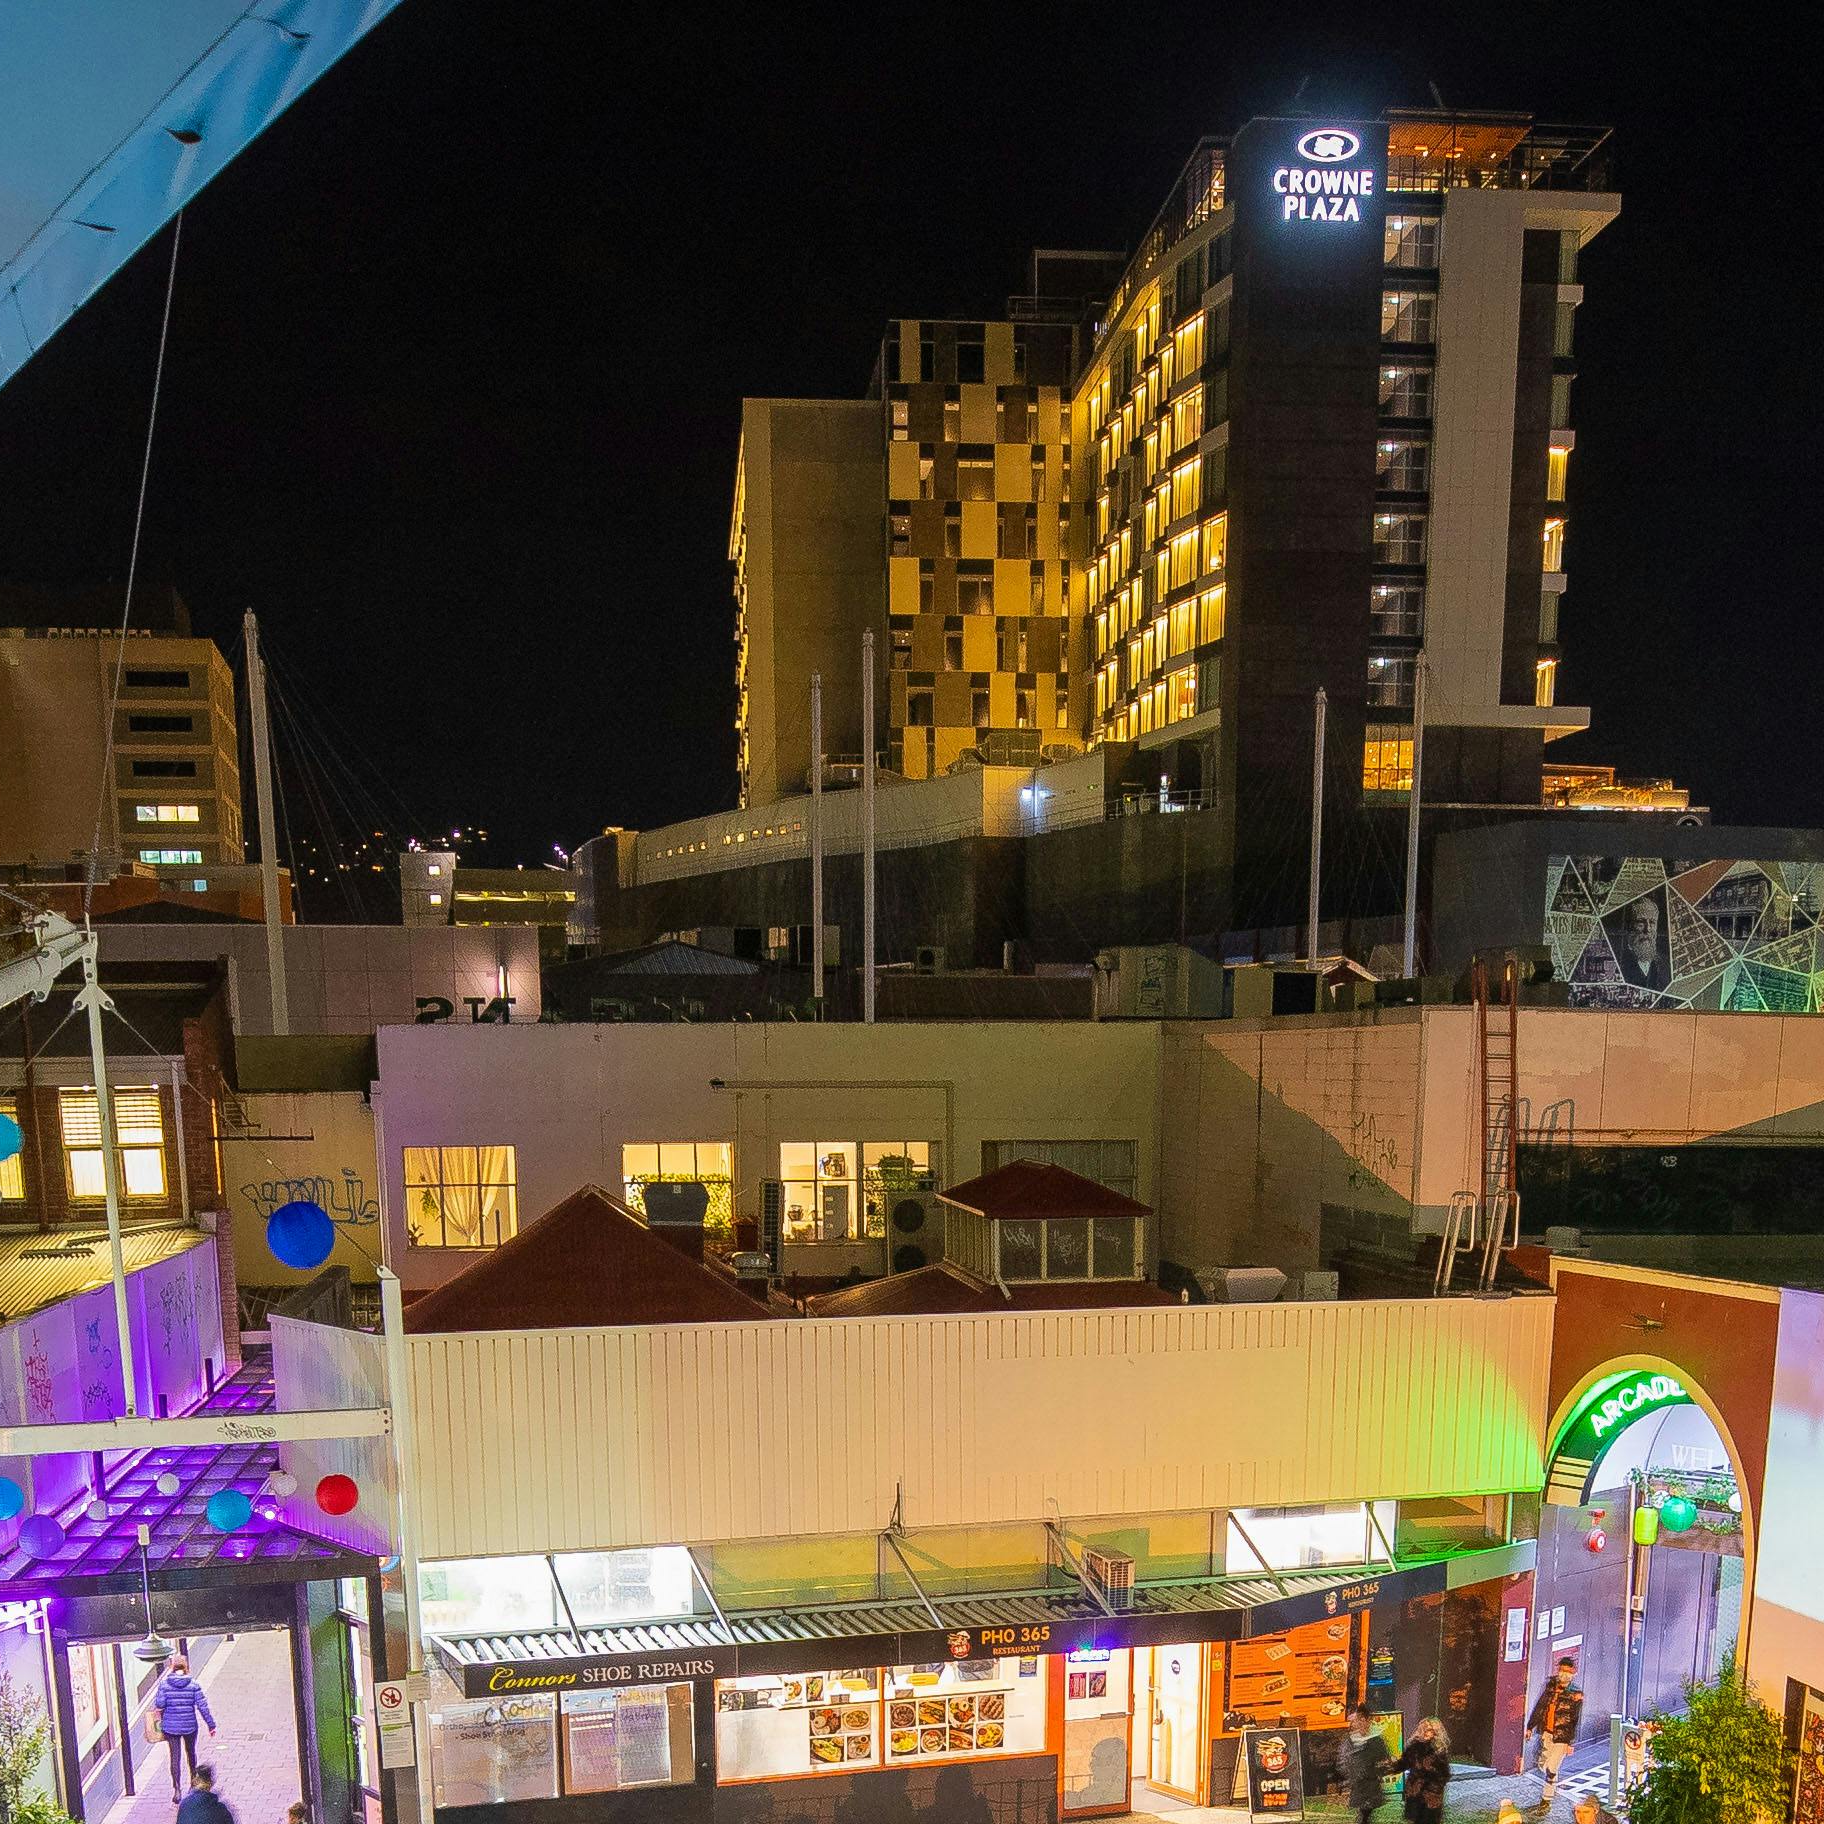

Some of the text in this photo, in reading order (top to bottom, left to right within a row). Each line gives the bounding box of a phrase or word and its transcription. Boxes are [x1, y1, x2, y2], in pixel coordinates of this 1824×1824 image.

[1274, 168, 1373, 196] CROWNE
[1283, 195, 1360, 222] PLAZA
[981, 1625, 1051, 1645] PHO 365
[992, 1645, 1041, 1656] RESTAURANT
[489, 1658, 715, 1691] Connors SHOE REPAIRS
[1260, 1778, 1291, 1792] OPEN
